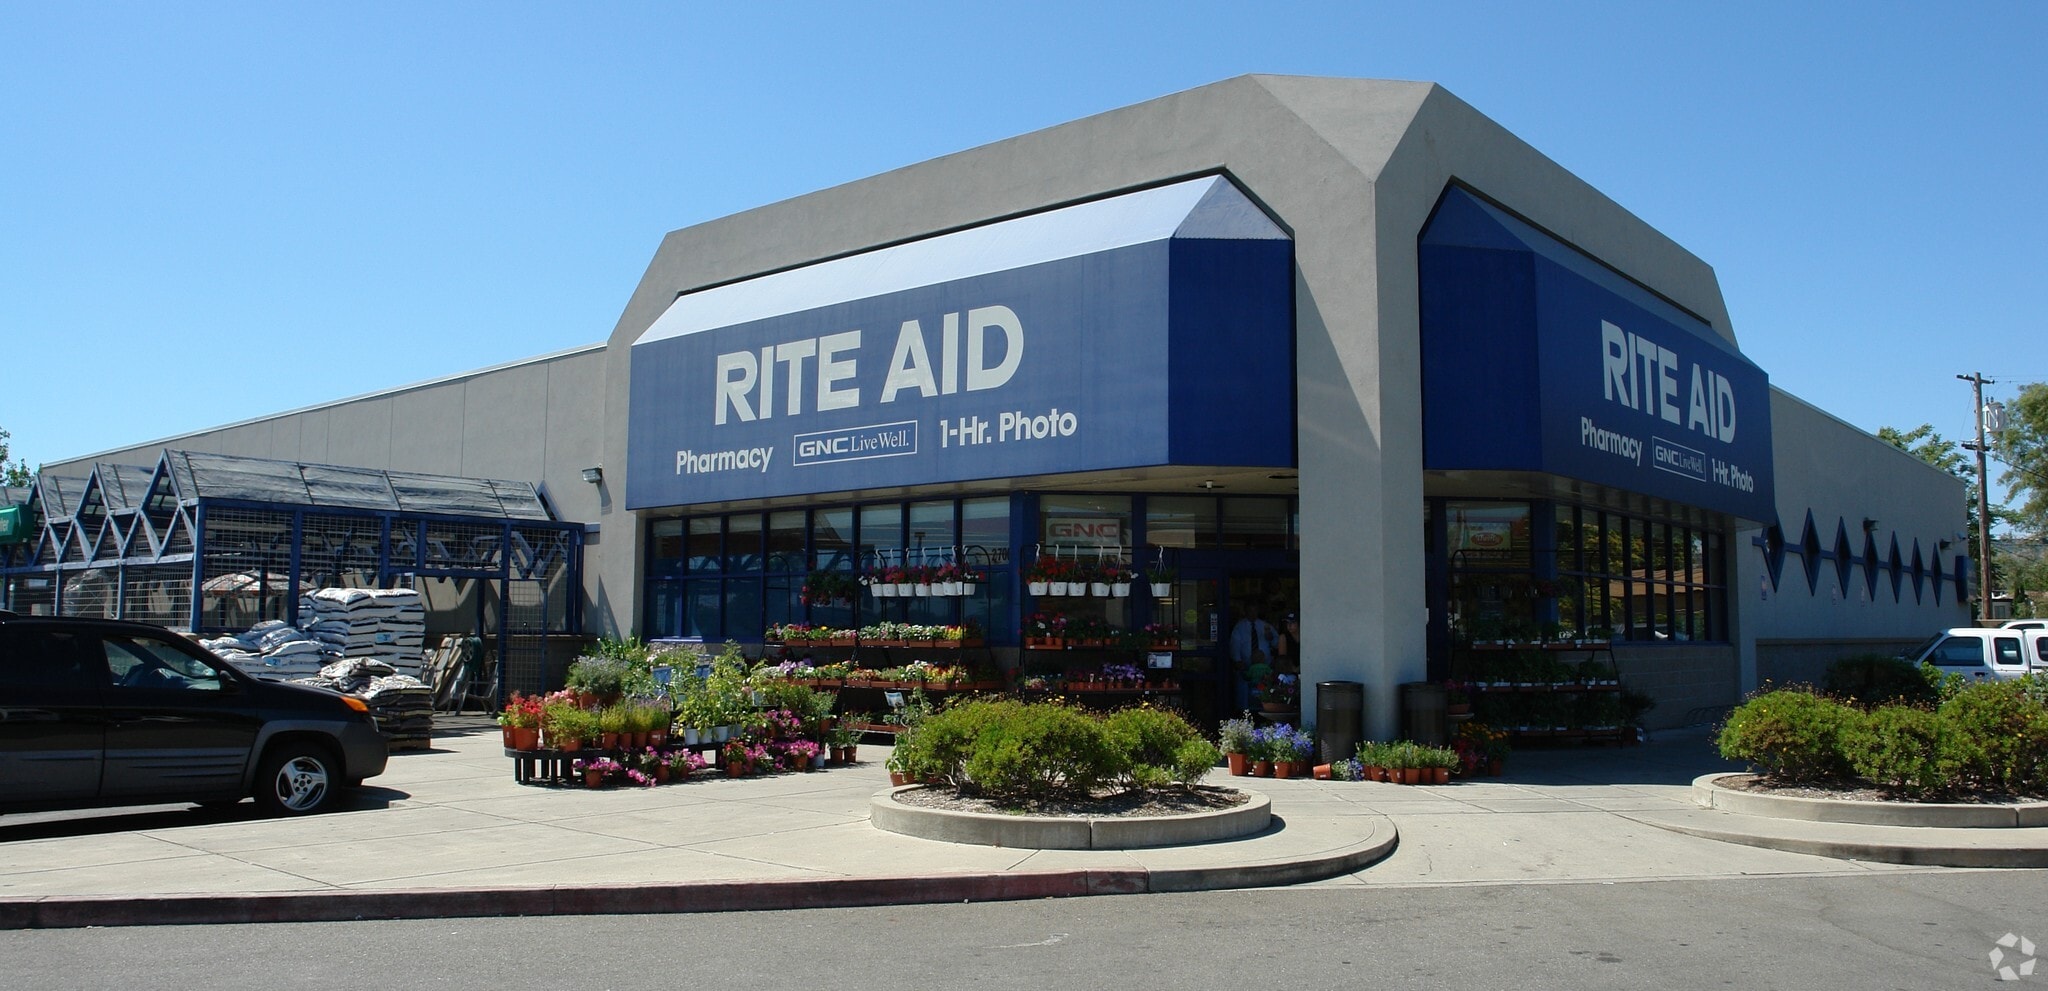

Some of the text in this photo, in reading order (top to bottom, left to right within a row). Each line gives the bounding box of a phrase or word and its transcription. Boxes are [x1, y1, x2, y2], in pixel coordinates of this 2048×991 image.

[715, 305, 1024, 425] RITE AID
[1601, 319, 1736, 444] RITE AID
[940, 408, 1078, 448] 1-Hr. Photo
[1581, 416, 1643, 466] Pharmacy
[676, 446, 774, 475] Pharmacy
[799, 437, 849, 457] GNC
[1655, 445, 1679, 467] GNC
[1712, 458, 1754, 493] 1-Hr. Photo
[1049, 523, 1117, 538] GNC
